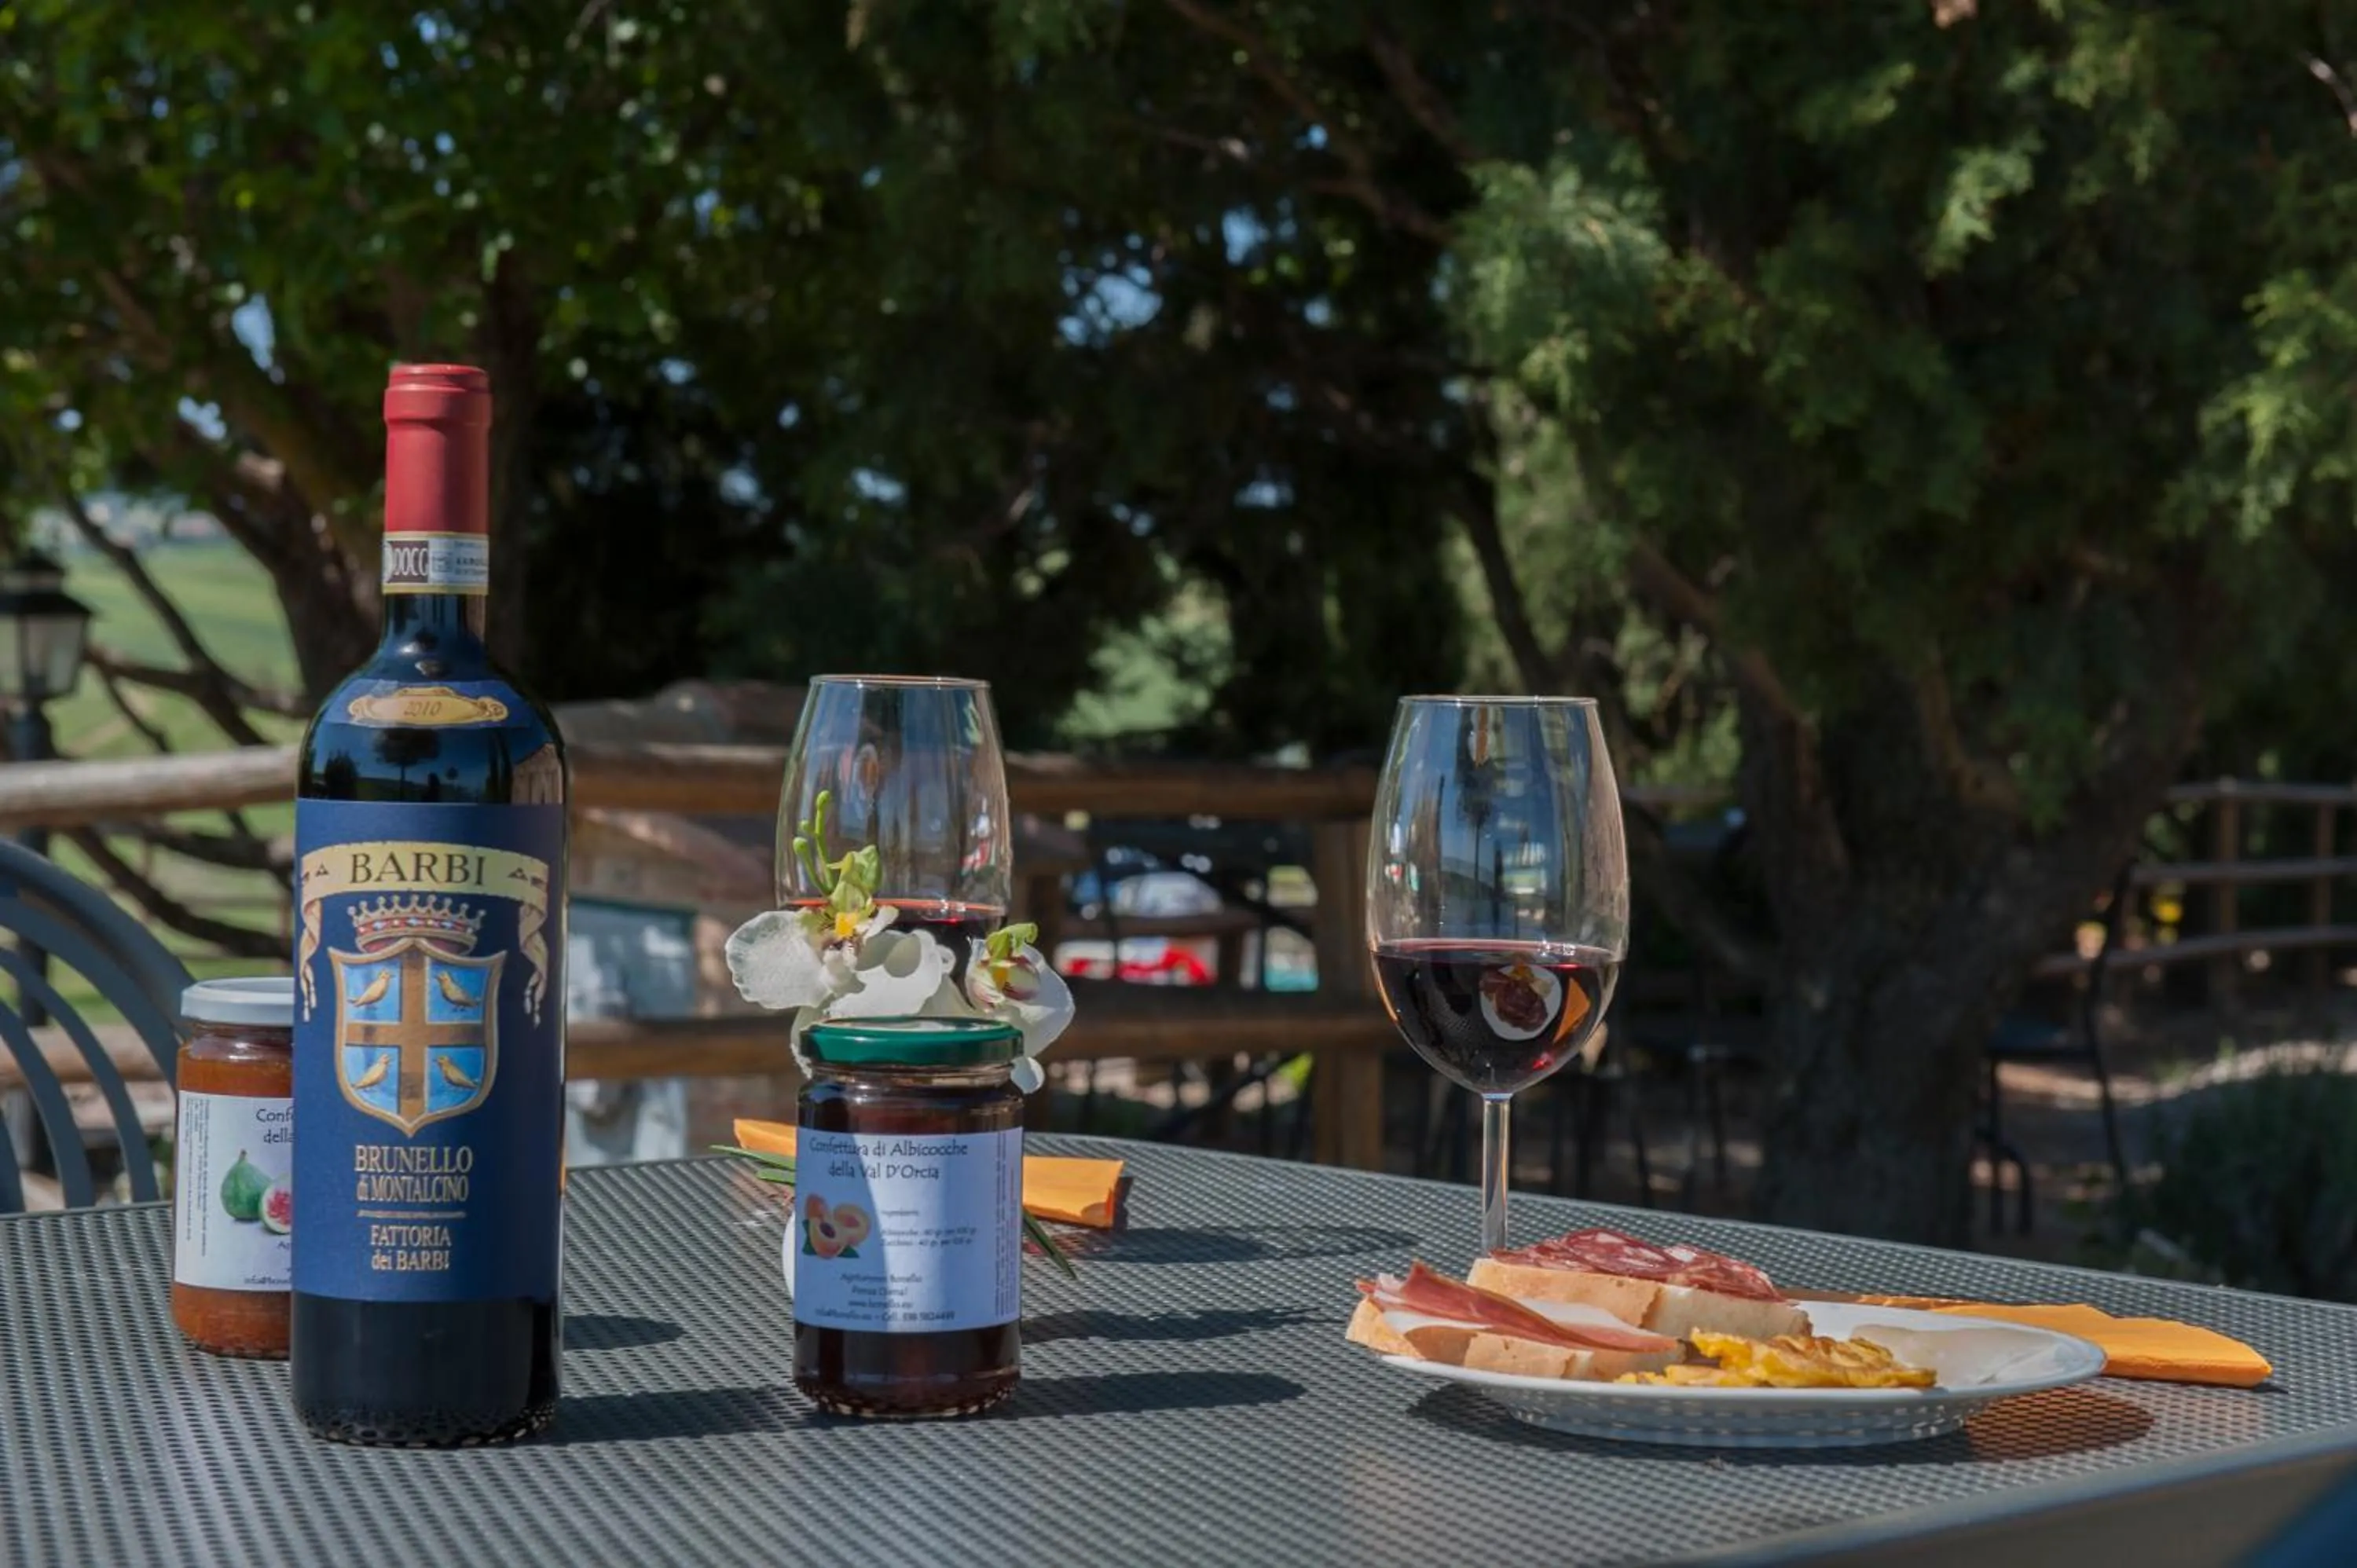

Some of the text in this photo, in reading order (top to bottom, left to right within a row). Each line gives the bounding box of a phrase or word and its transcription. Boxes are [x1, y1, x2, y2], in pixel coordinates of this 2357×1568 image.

[403, 701, 443, 717] 2010
[350, 852, 486, 886] BARBI
[809, 1136, 968, 1156] Confettura di Albicocche
[354, 1145, 473, 1173] BRUNELLO
[828, 1156, 855, 1178] della
[860, 1163, 881, 1179] Val
[370, 1176, 469, 1203] MONTALCINO
[370, 1224, 453, 1247] FATTORIA
[371, 1248, 450, 1271] dei BARBI
